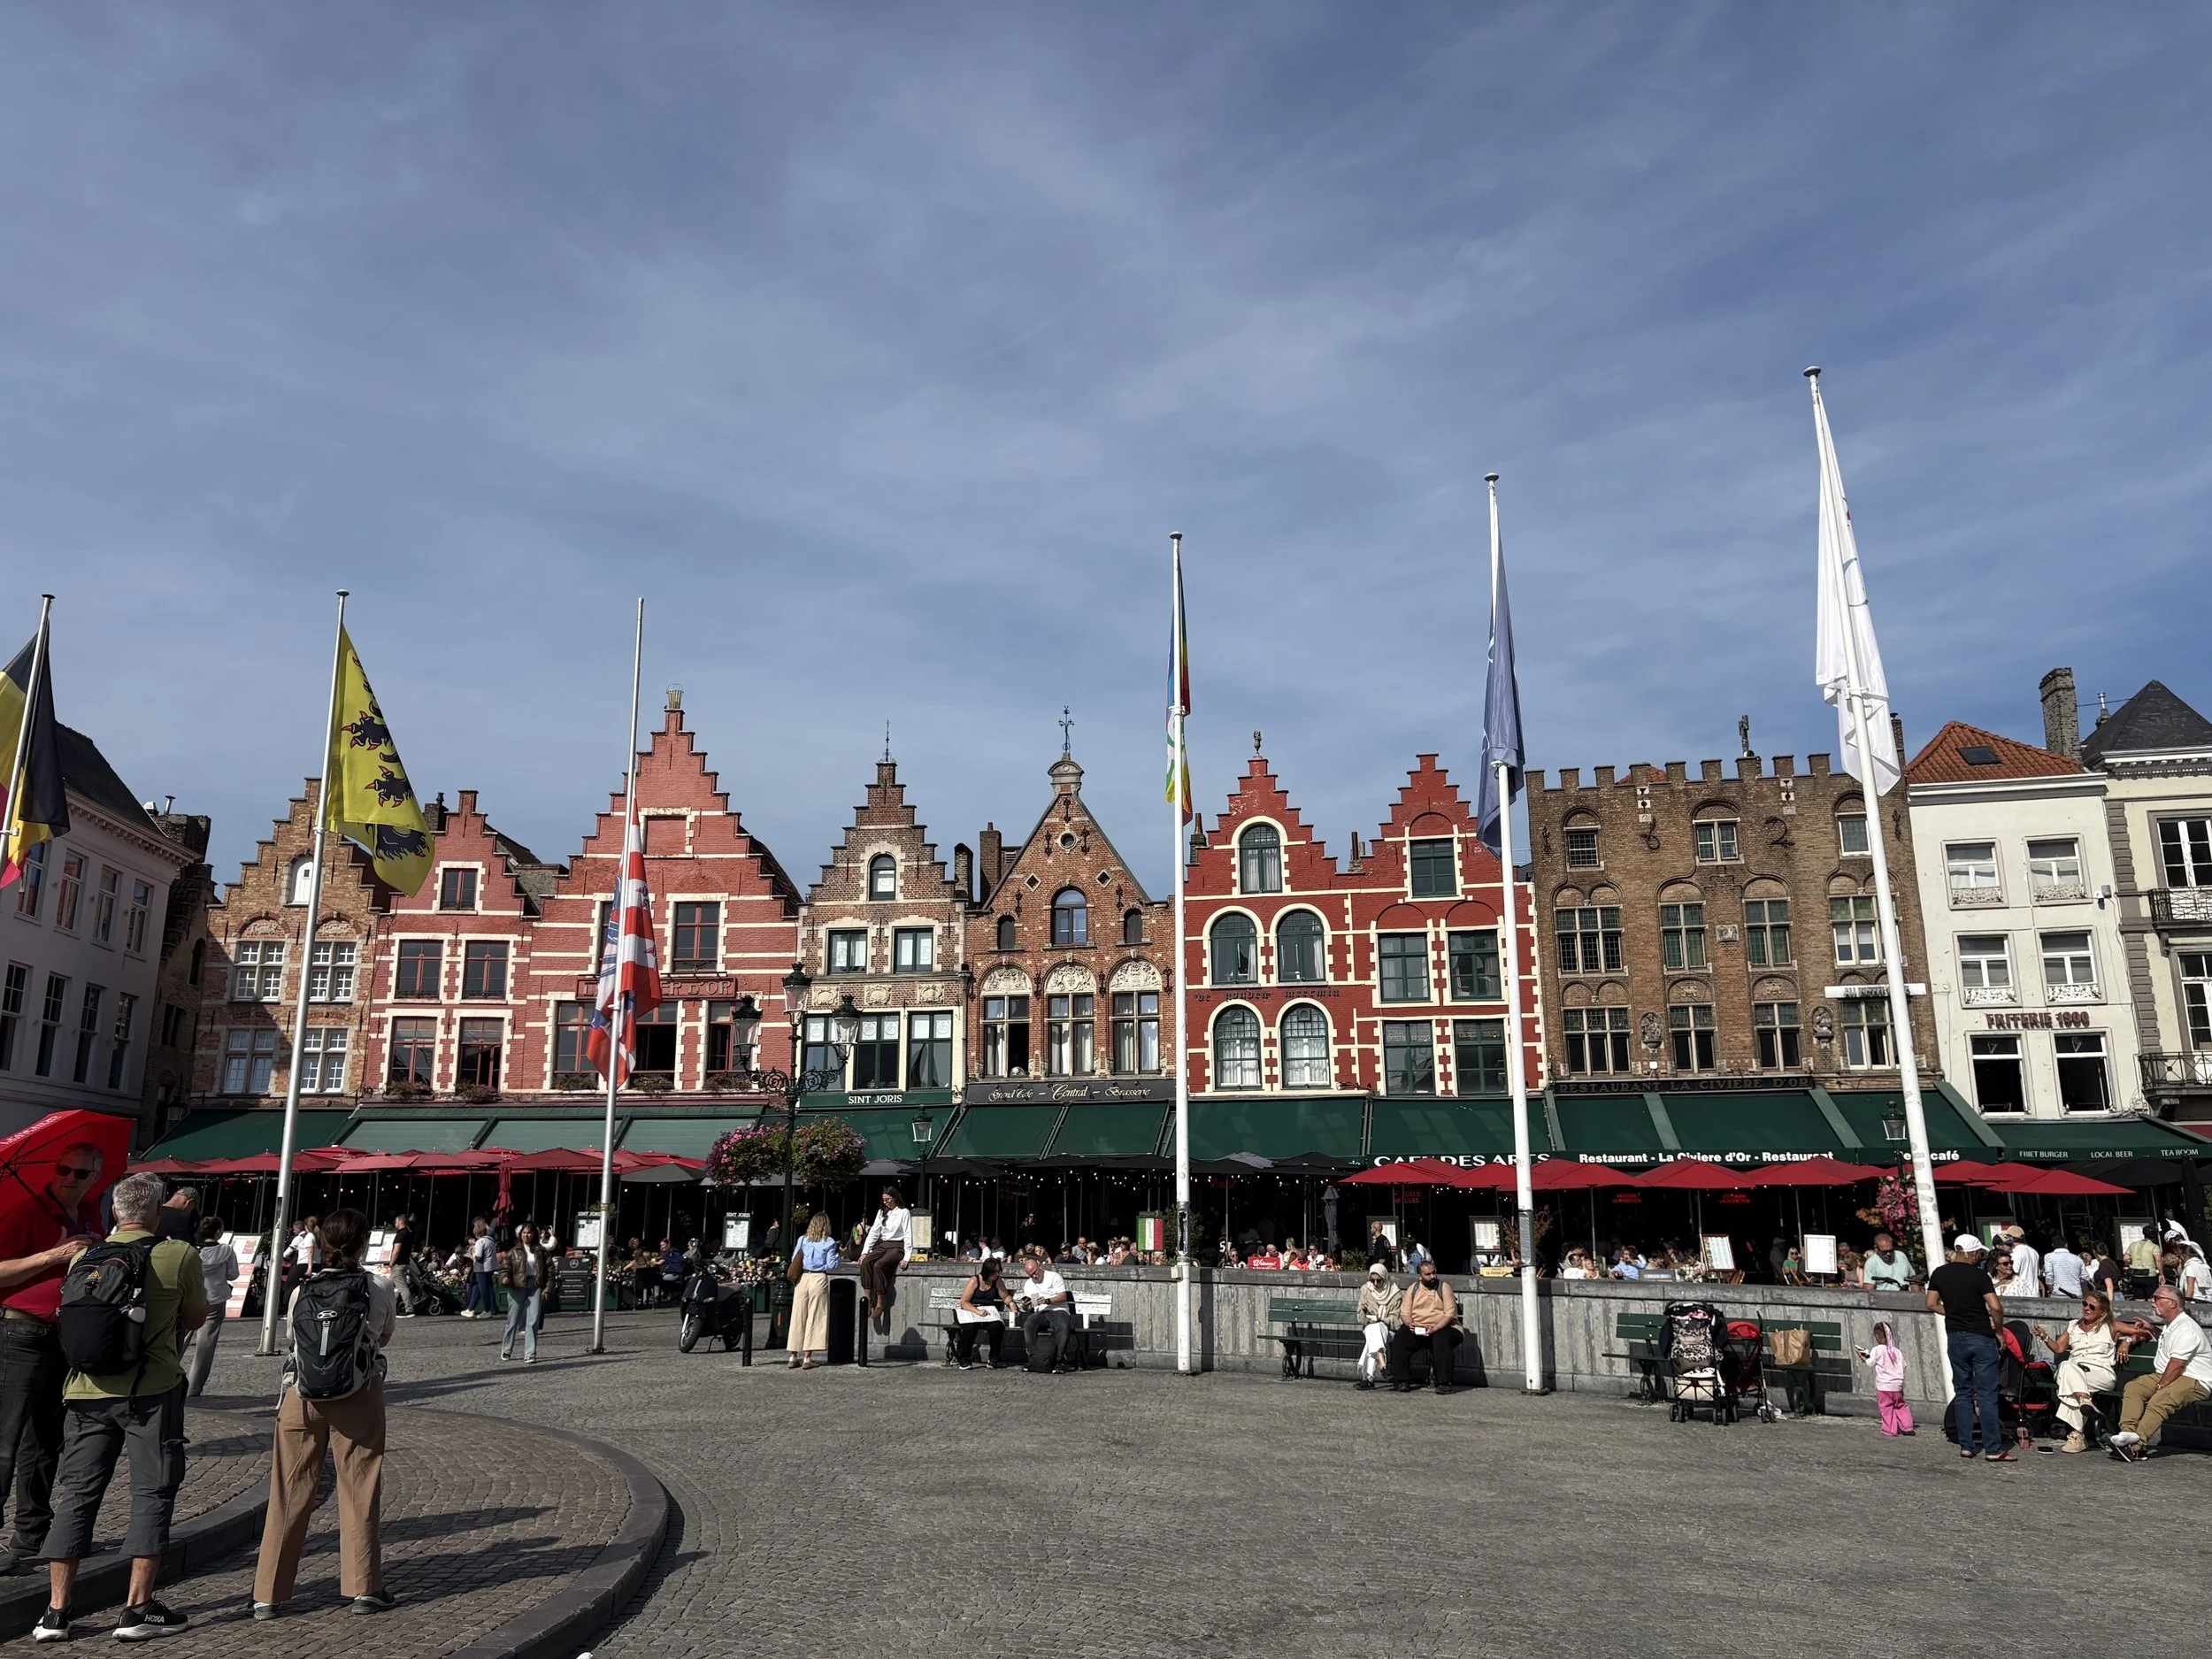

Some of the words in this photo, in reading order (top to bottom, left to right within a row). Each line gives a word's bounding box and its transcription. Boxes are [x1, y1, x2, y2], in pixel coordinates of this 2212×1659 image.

[687, 980, 732, 995] D'OR
[2055, 1011, 2089, 1028] 1900
[1559, 1082, 1661, 1094] RESTAURANT
[1671, 1081, 1693, 1091] LA
[1699, 1079, 1763, 1090] CIVIERE
[1772, 1077, 1809, 1087] D'OR
[1051, 1084, 1087, 1100] Central
[1104, 1087, 1151, 1097] Brasserie
[848, 1095, 872, 1104] SINT
[874, 1094, 902, 1103] JORIS
[1440, 1155, 1486, 1166] DES
[1578, 1153, 1648, 1164] Restaurant
[1658, 1153, 1675, 1163] La
[1724, 1152, 1751, 1163] d'Or
[1930, 1150, 1960, 1161] café
[144, 1614, 165, 1624] HOKA
